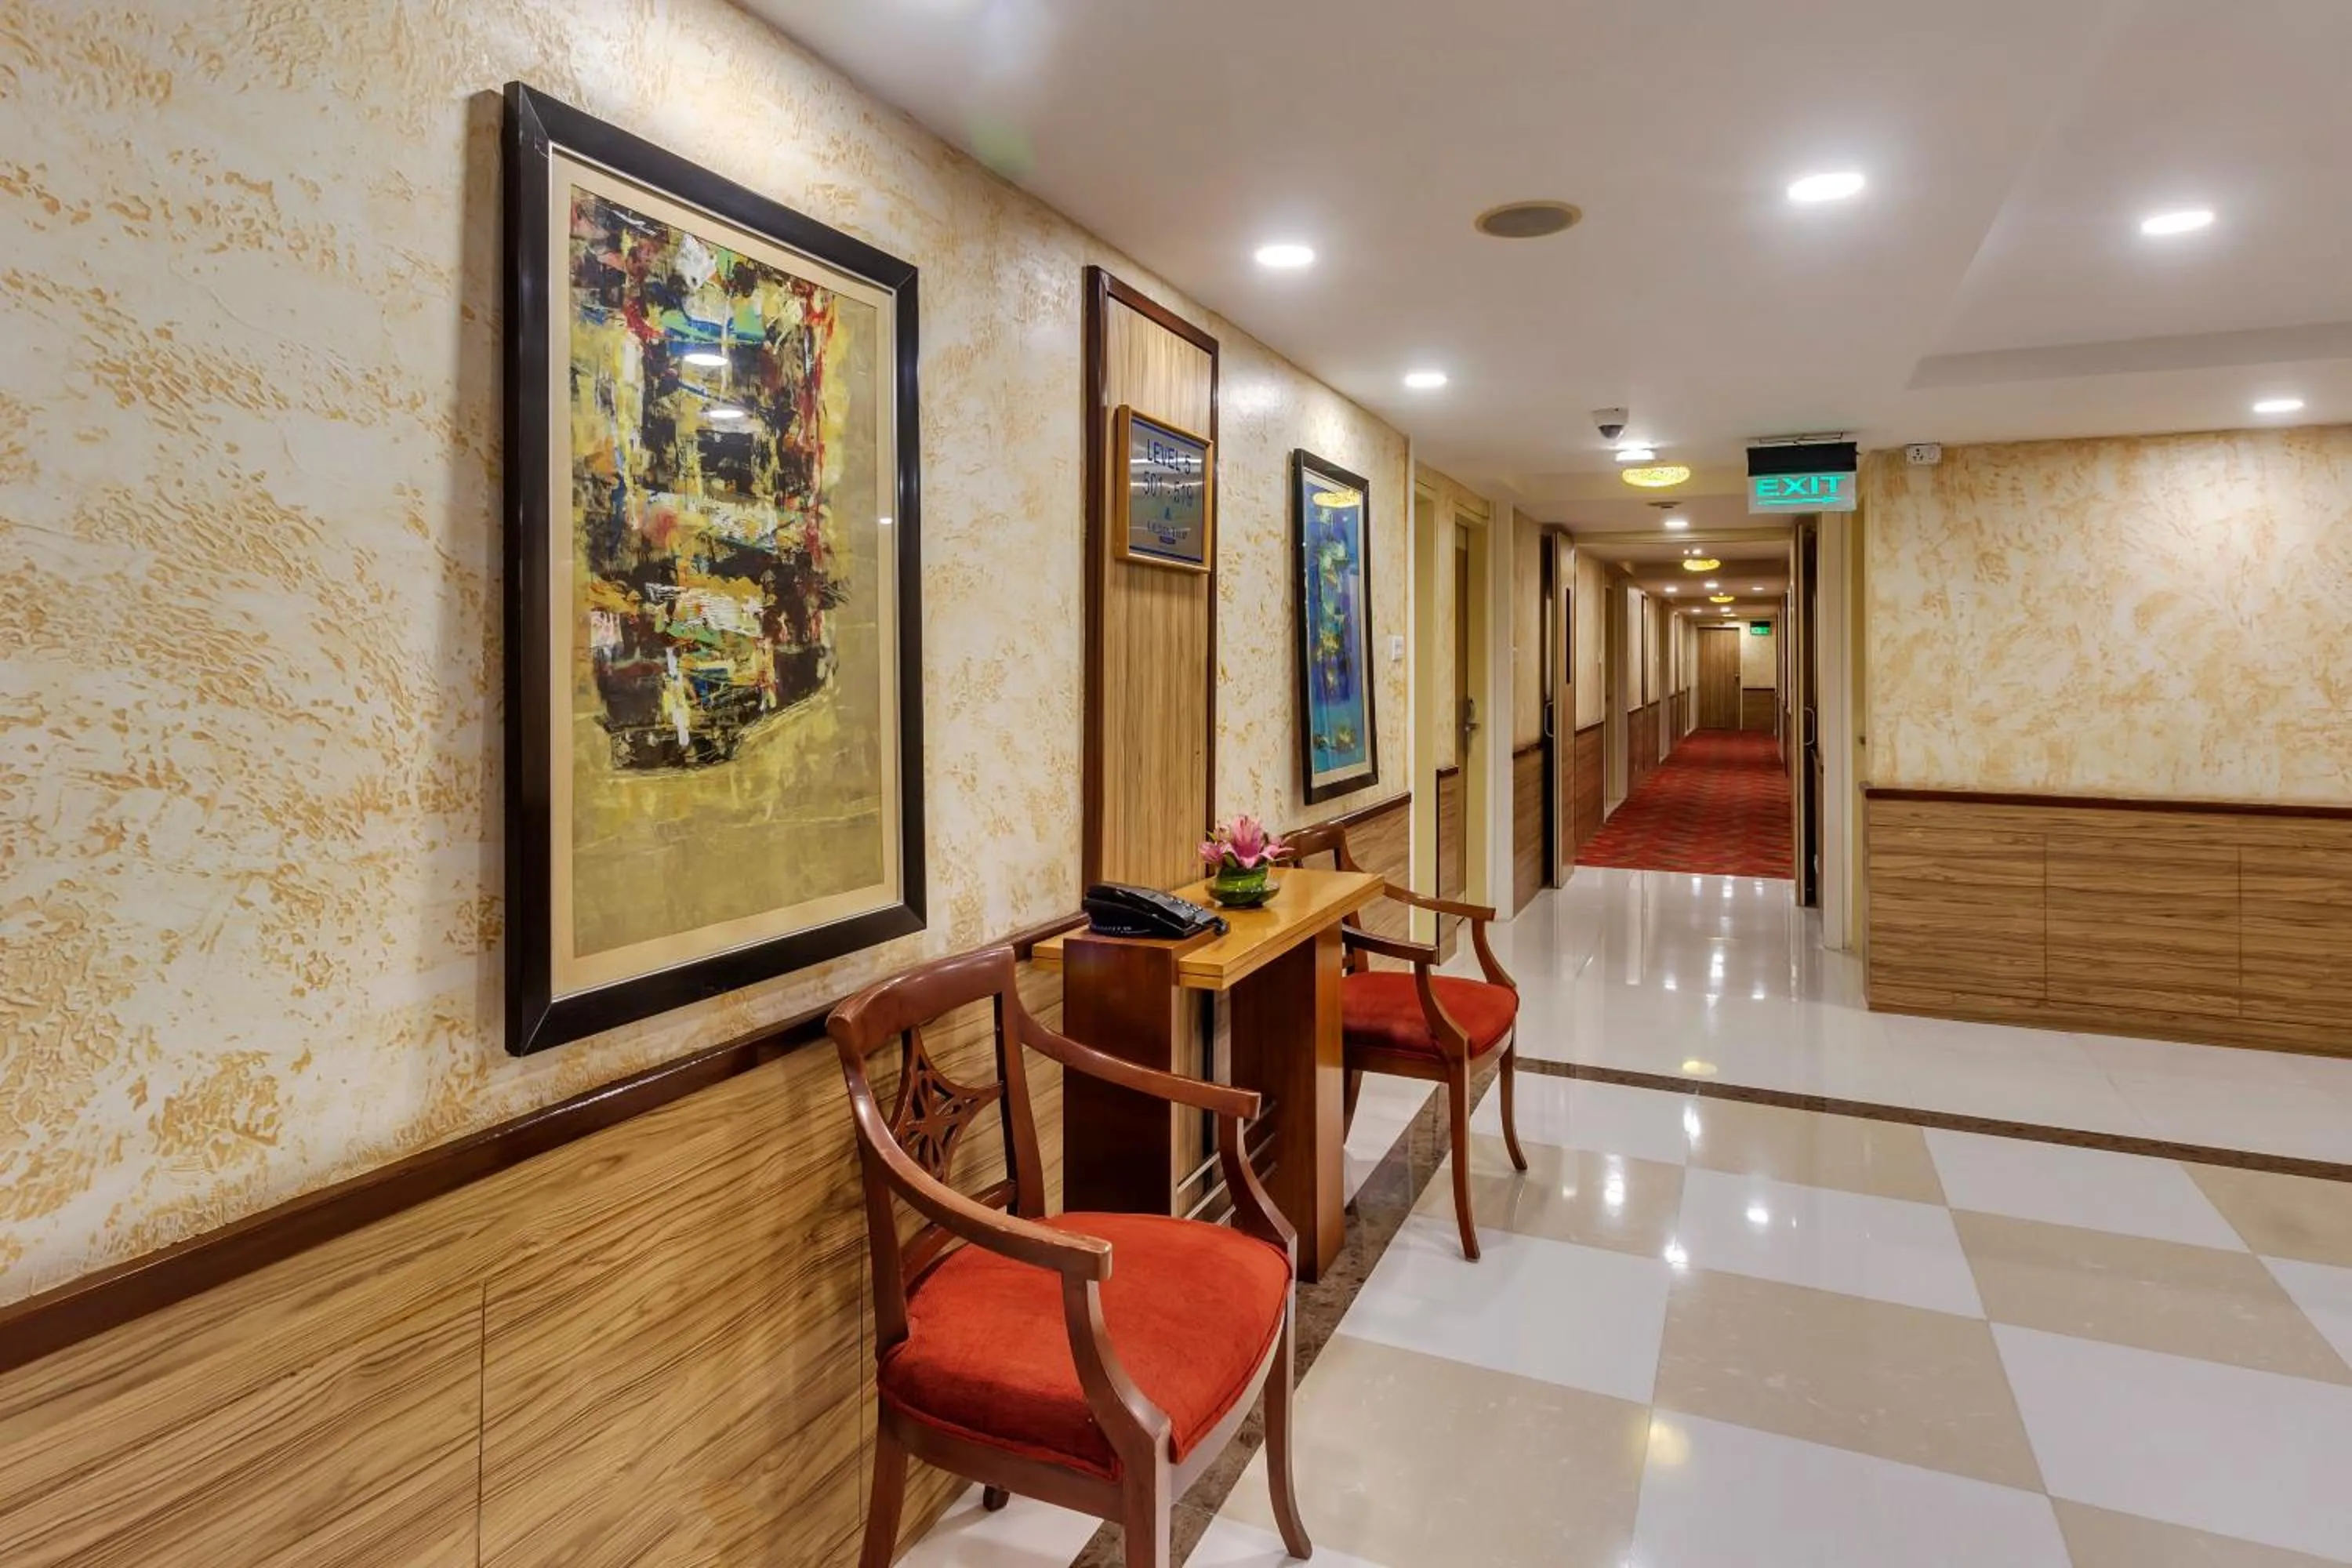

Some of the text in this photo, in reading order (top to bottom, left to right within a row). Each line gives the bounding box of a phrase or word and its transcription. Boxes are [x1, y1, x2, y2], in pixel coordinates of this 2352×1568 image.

[1147, 438, 1192, 475] LEVEL 5
[1755, 476, 1846, 497] EXIT
